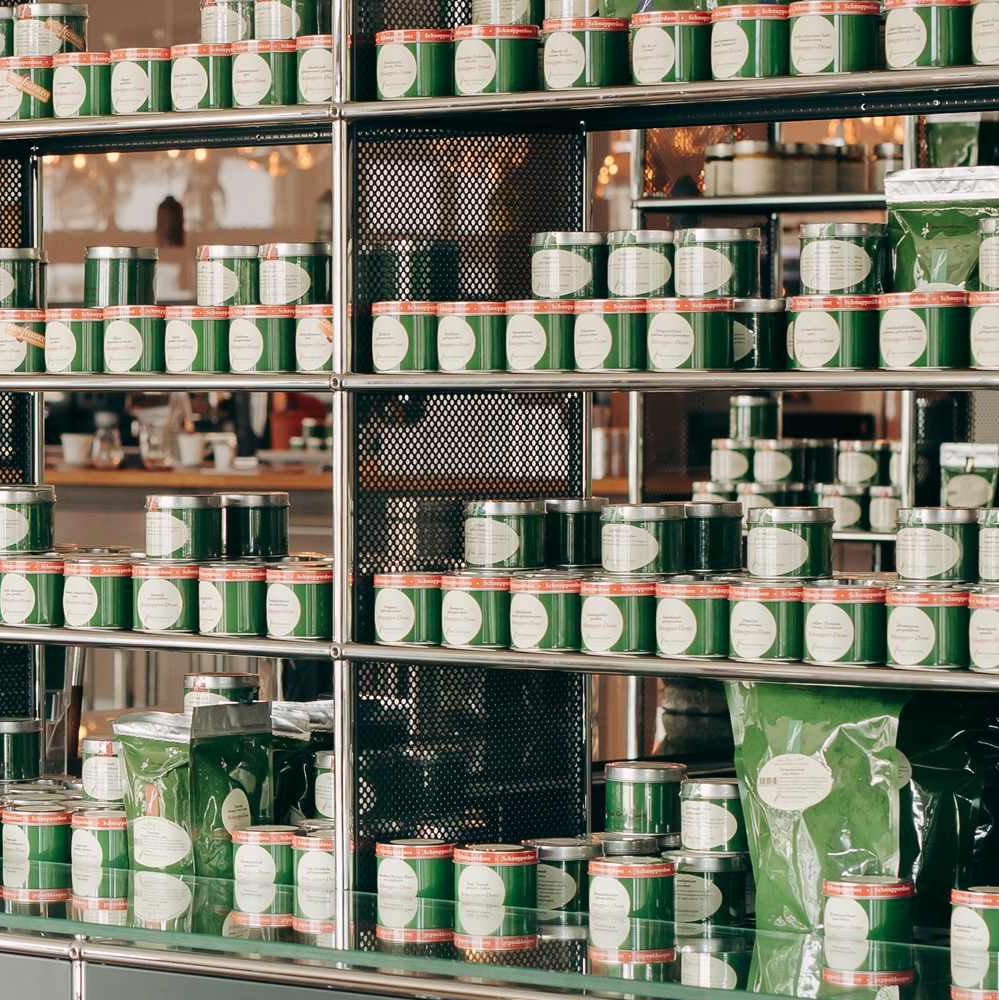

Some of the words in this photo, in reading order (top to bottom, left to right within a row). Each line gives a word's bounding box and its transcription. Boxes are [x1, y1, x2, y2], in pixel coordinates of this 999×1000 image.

[794, 3, 832, 11] Schnupperdose
[639, 15, 676, 23] Schnupperdose
[457, 854, 491, 862] Schnupperdose
